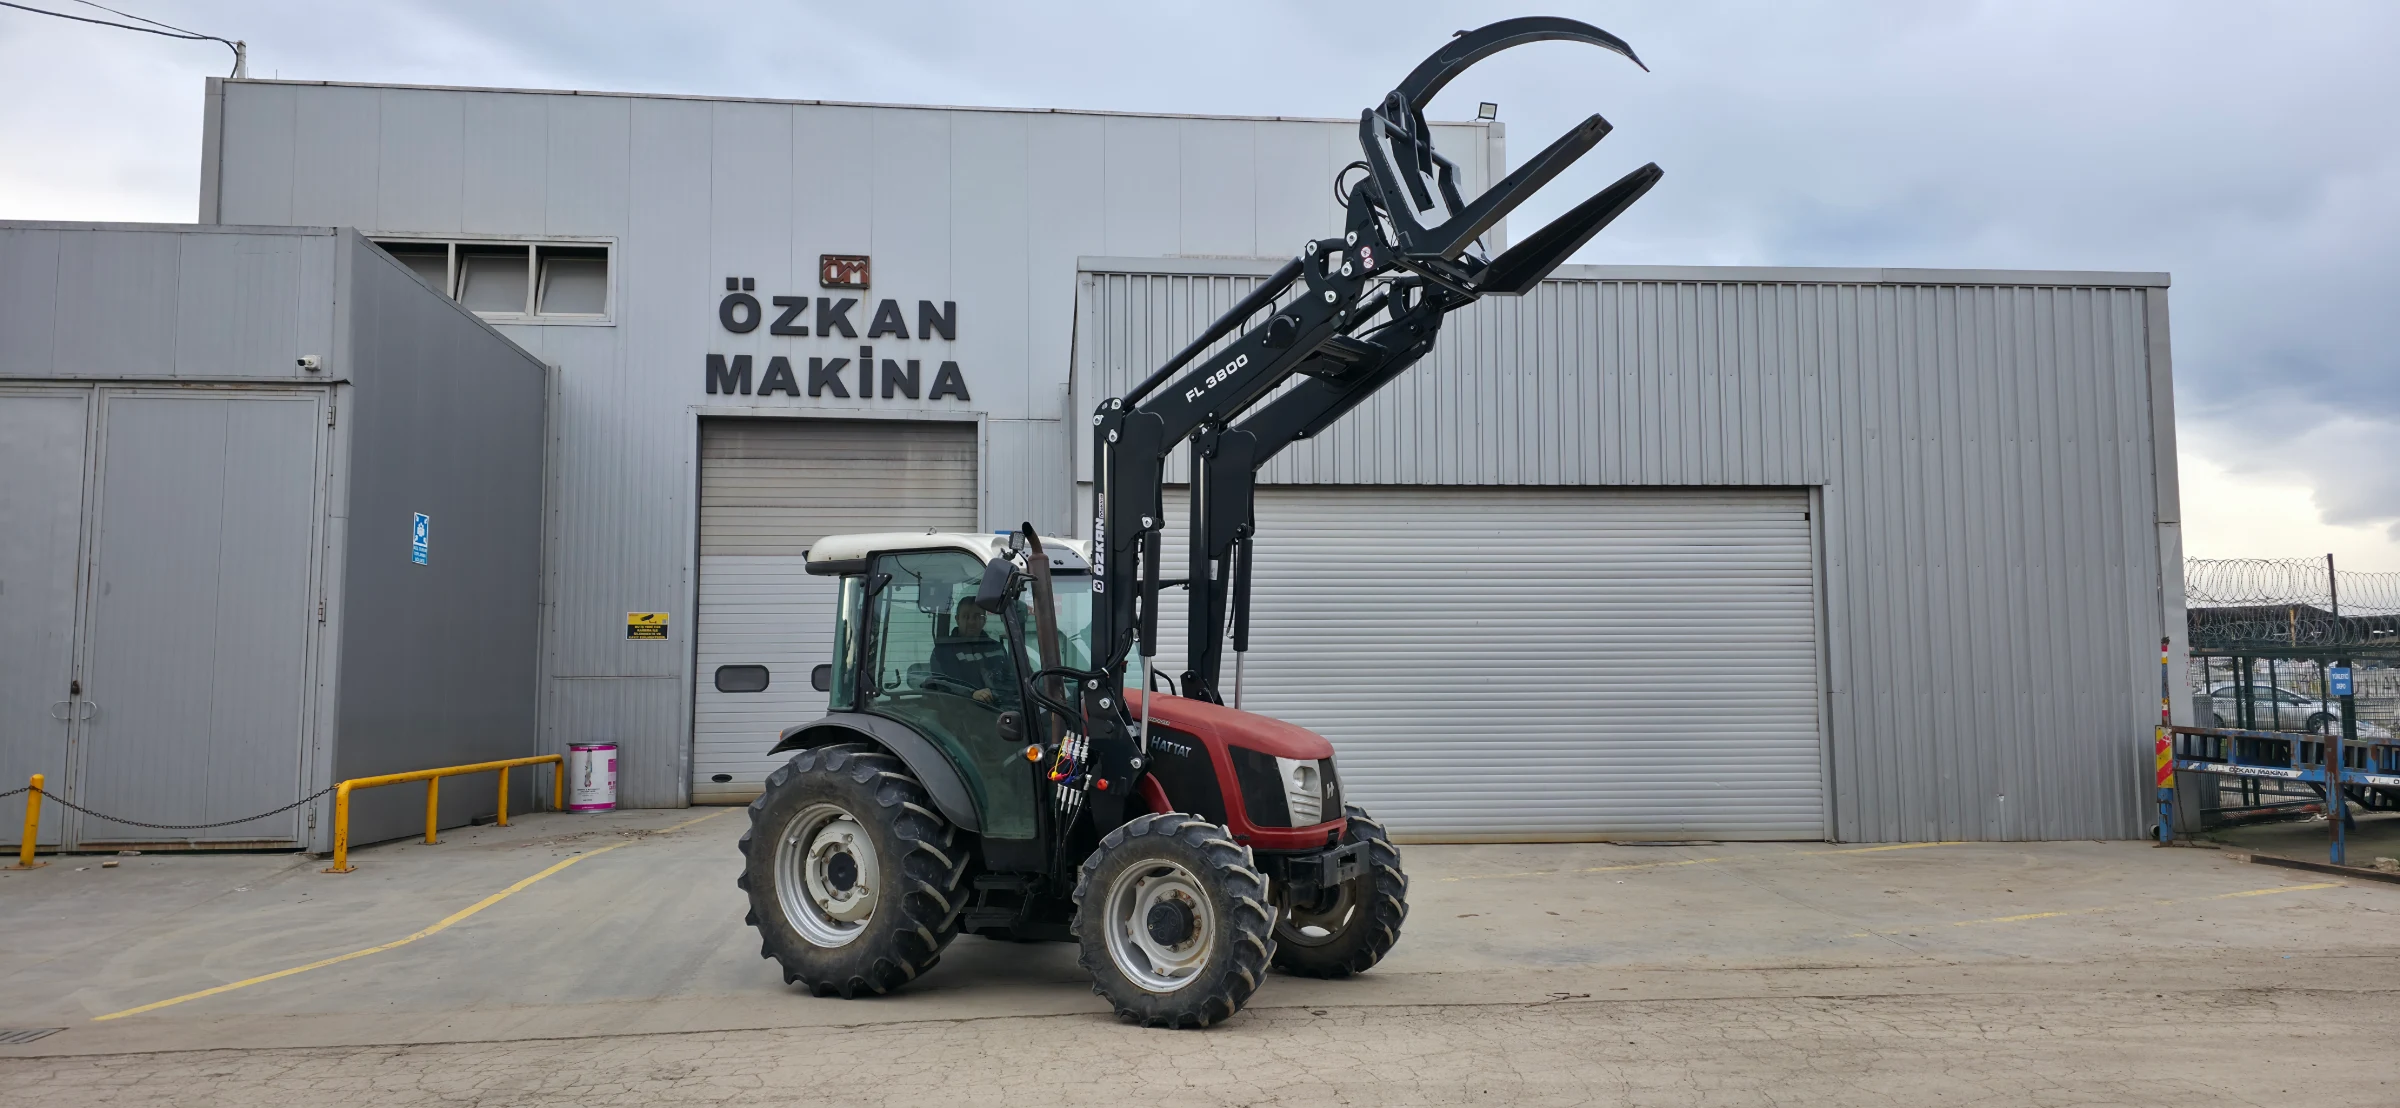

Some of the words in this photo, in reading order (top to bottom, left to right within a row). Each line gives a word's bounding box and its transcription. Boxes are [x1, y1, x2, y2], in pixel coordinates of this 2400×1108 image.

[719, 277, 956, 340] ÖZKAN
[706, 346, 970, 401] MAKİNA
[1185, 387, 1205, 403] FL
[1205, 354, 1249, 389] 3800
[1093, 517, 1105, 577] ÖZKAN
[1150, 735, 1192, 758] HATTAT
